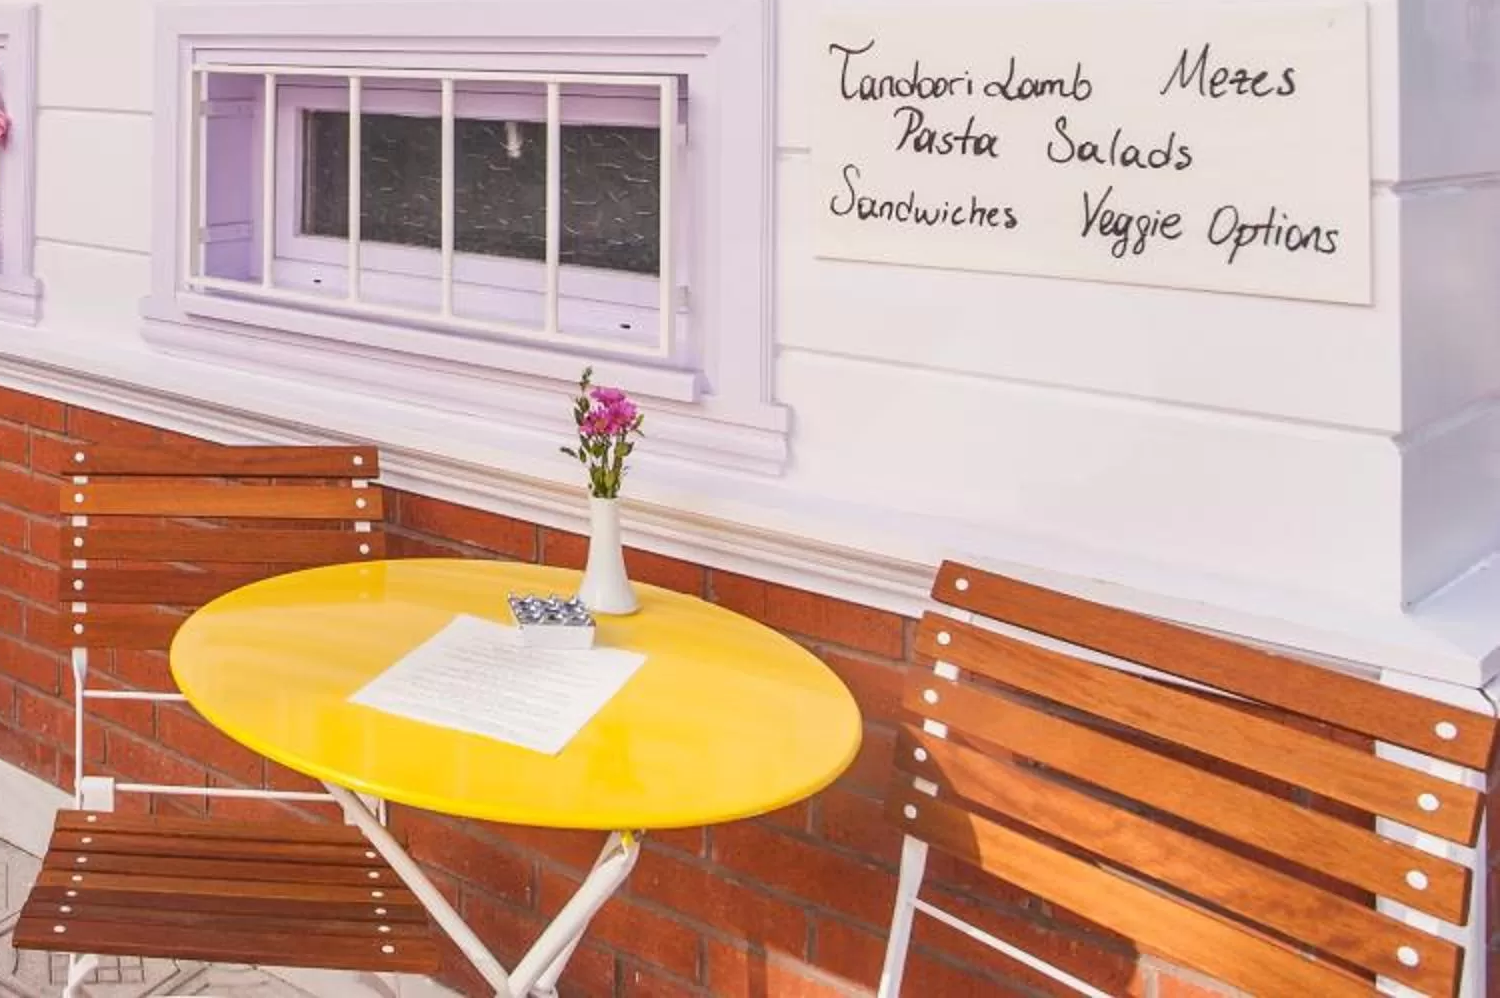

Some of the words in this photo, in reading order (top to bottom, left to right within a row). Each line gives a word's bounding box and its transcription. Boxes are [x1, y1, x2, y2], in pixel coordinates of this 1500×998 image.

[829, 40, 973, 101] Tandoori
[983, 57, 1093, 102] Lamb
[1159, 44, 1296, 99] Mezes
[893, 105, 1000, 159] Pasta
[1047, 115, 1193, 171] Salads
[829, 163, 1018, 229] Sandwiches
[1081, 185, 1183, 259] Veggie
[1207, 205, 1339, 265] Options
